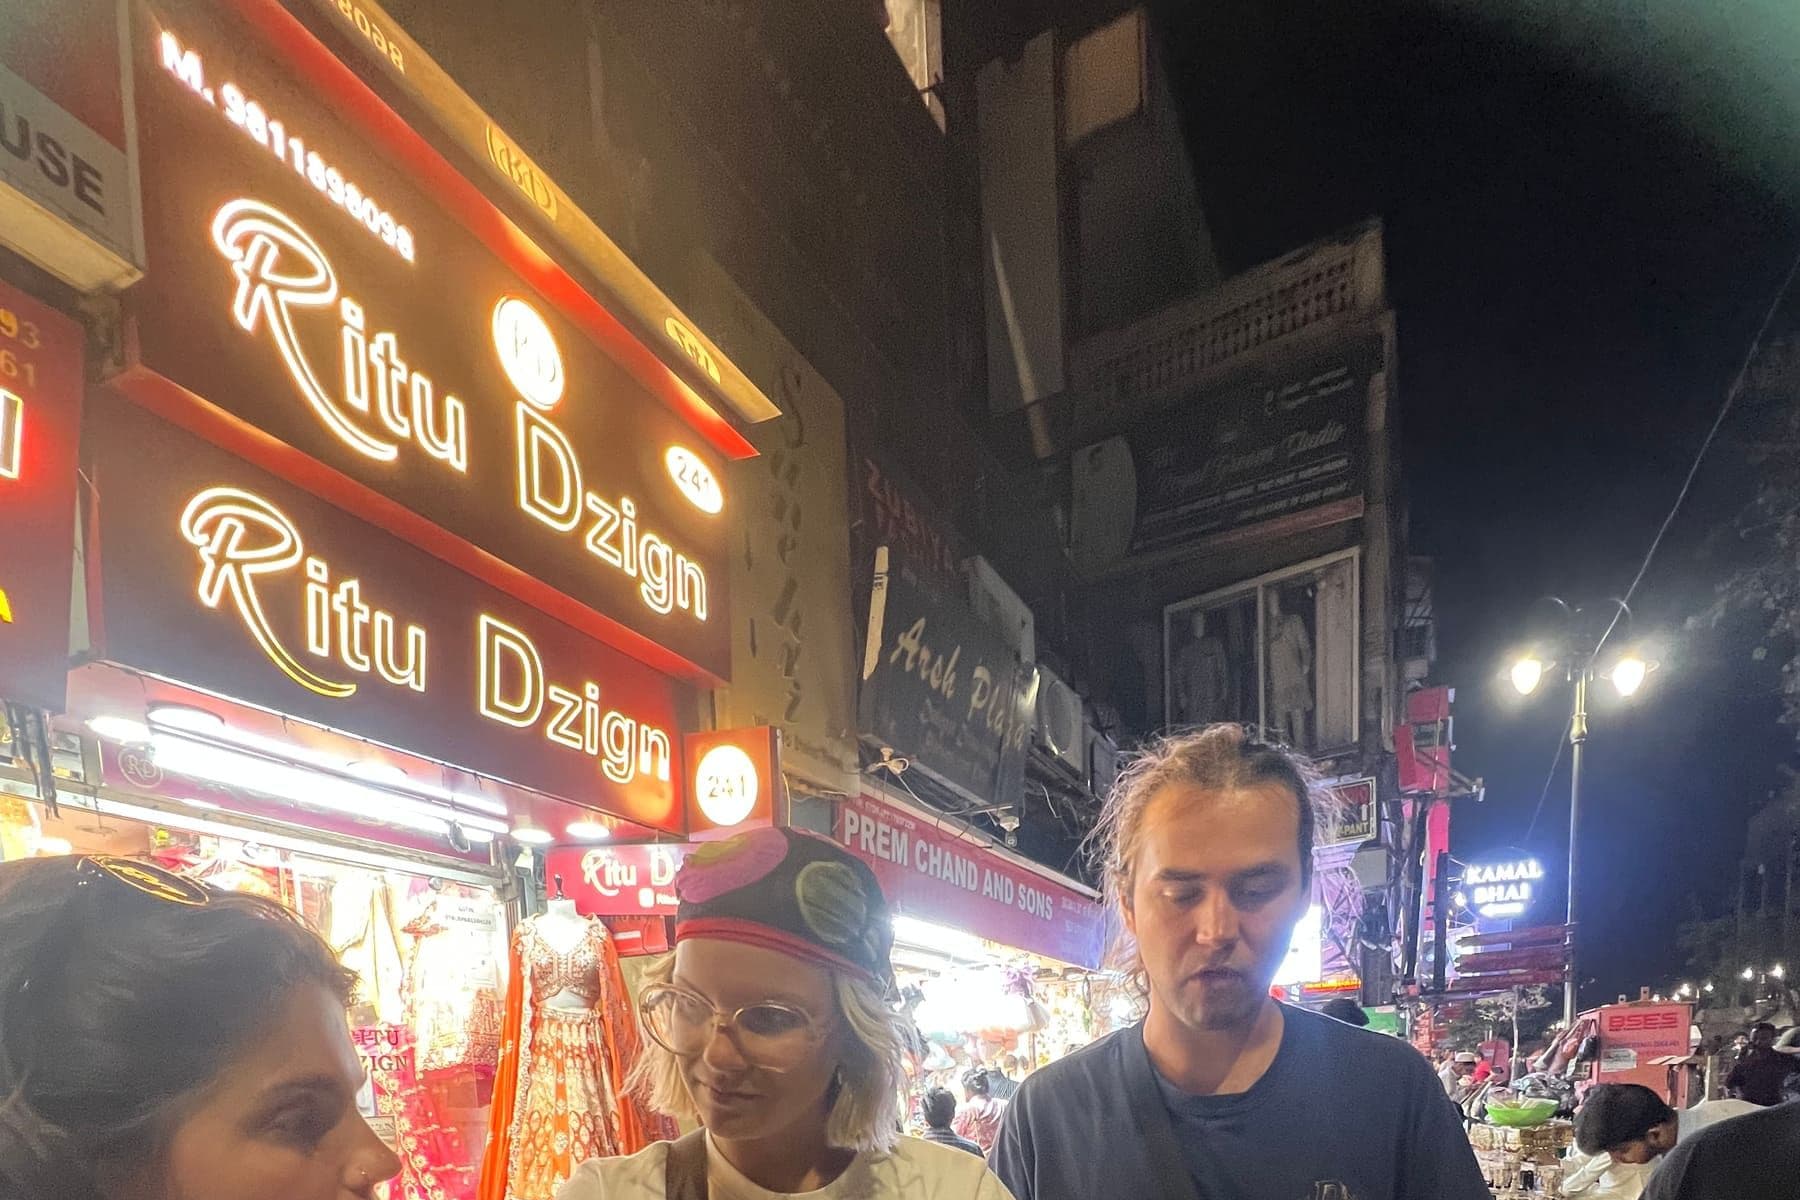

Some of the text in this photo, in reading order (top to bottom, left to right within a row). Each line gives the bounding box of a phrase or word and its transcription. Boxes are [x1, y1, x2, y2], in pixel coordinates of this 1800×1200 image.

[210, 198, 468, 473] Ritu
[515, 400, 708, 622] Dzign
[180, 487, 671, 783] Ritu Dzign
[581, 848, 637, 896] Ritu
[844, 807, 909, 867] PREM
[914, 839, 978, 891] CHAND
[983, 868, 1014, 905] AND
[1018, 883, 1053, 920] SONS
[1466, 859, 1544, 885] KAMAL
[1474, 882, 1530, 904] BHAI
[1608, 1012, 1678, 1028] BSES
